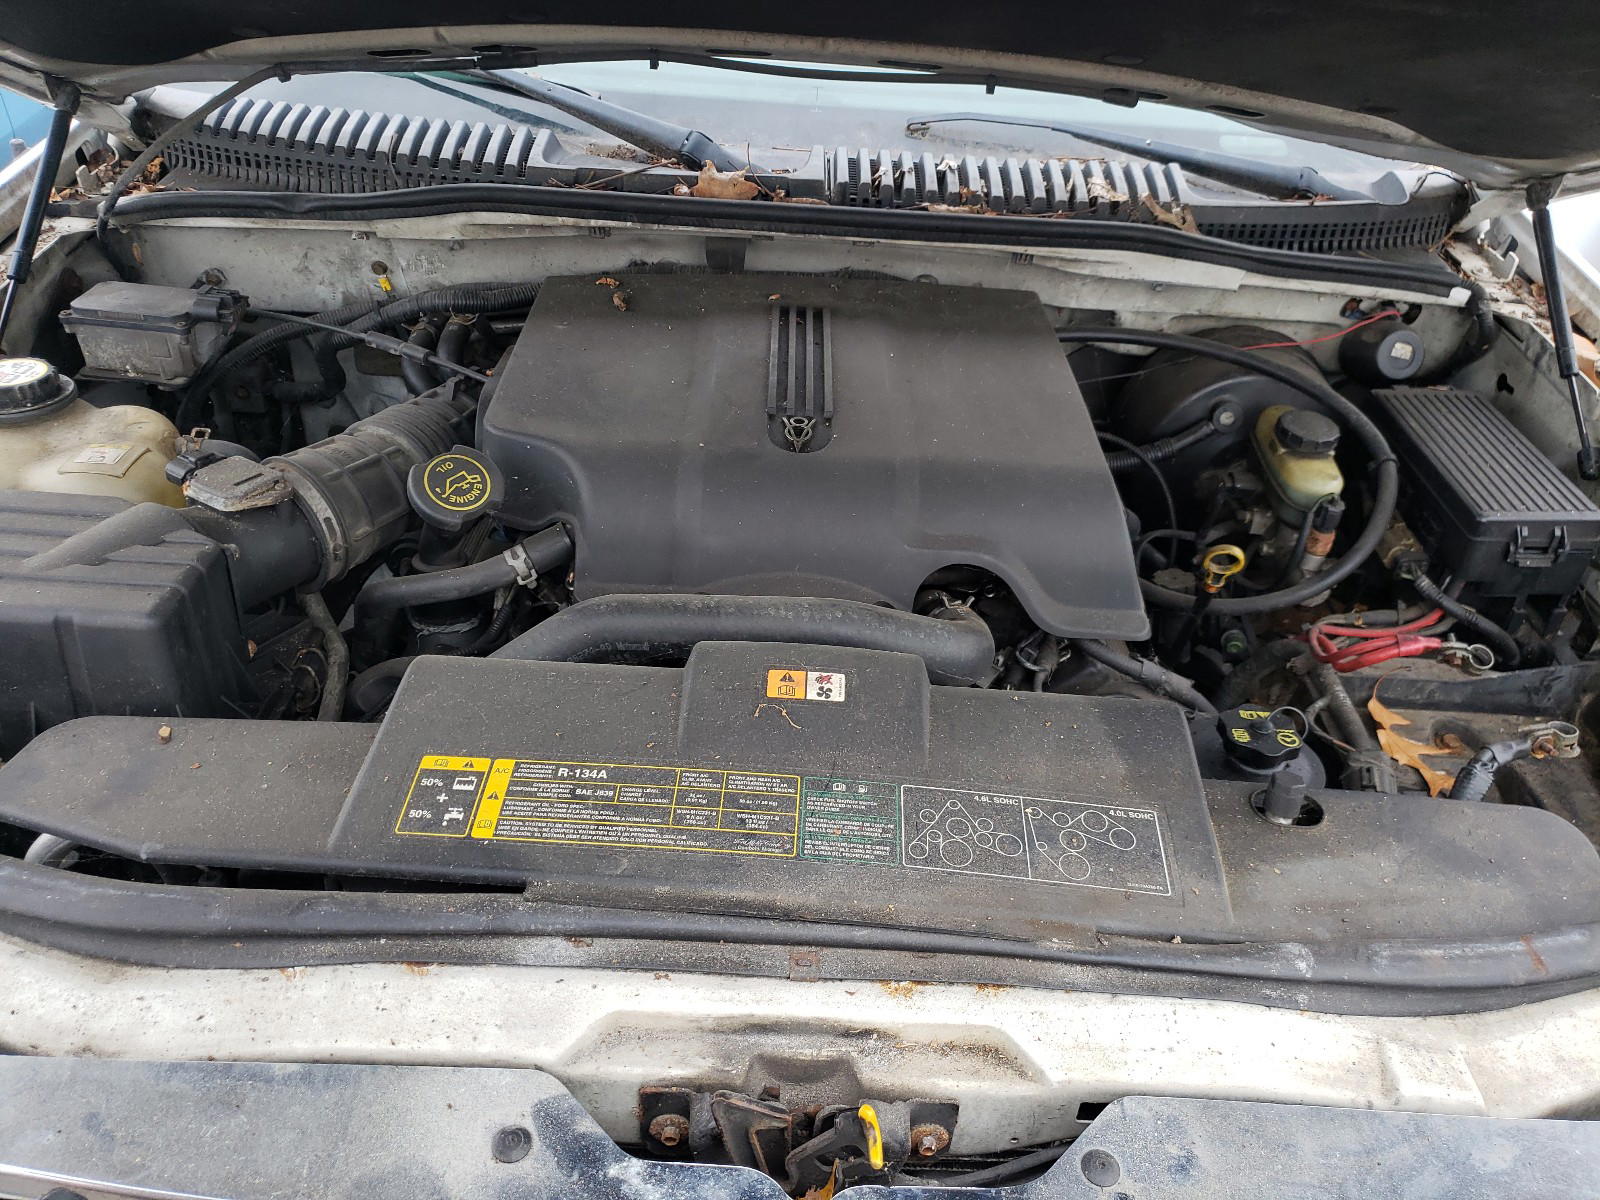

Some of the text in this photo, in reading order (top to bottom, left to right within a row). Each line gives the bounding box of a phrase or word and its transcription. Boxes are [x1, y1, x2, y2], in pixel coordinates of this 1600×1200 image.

[436, 462, 454, 472] OIL
[449, 484, 482, 504] ENGINE
[558, 768, 607, 779] R-134A
[420, 778, 443, 786] 50%
[994, 797, 1018, 806] SOHC
[408, 810, 431, 818] 50%
